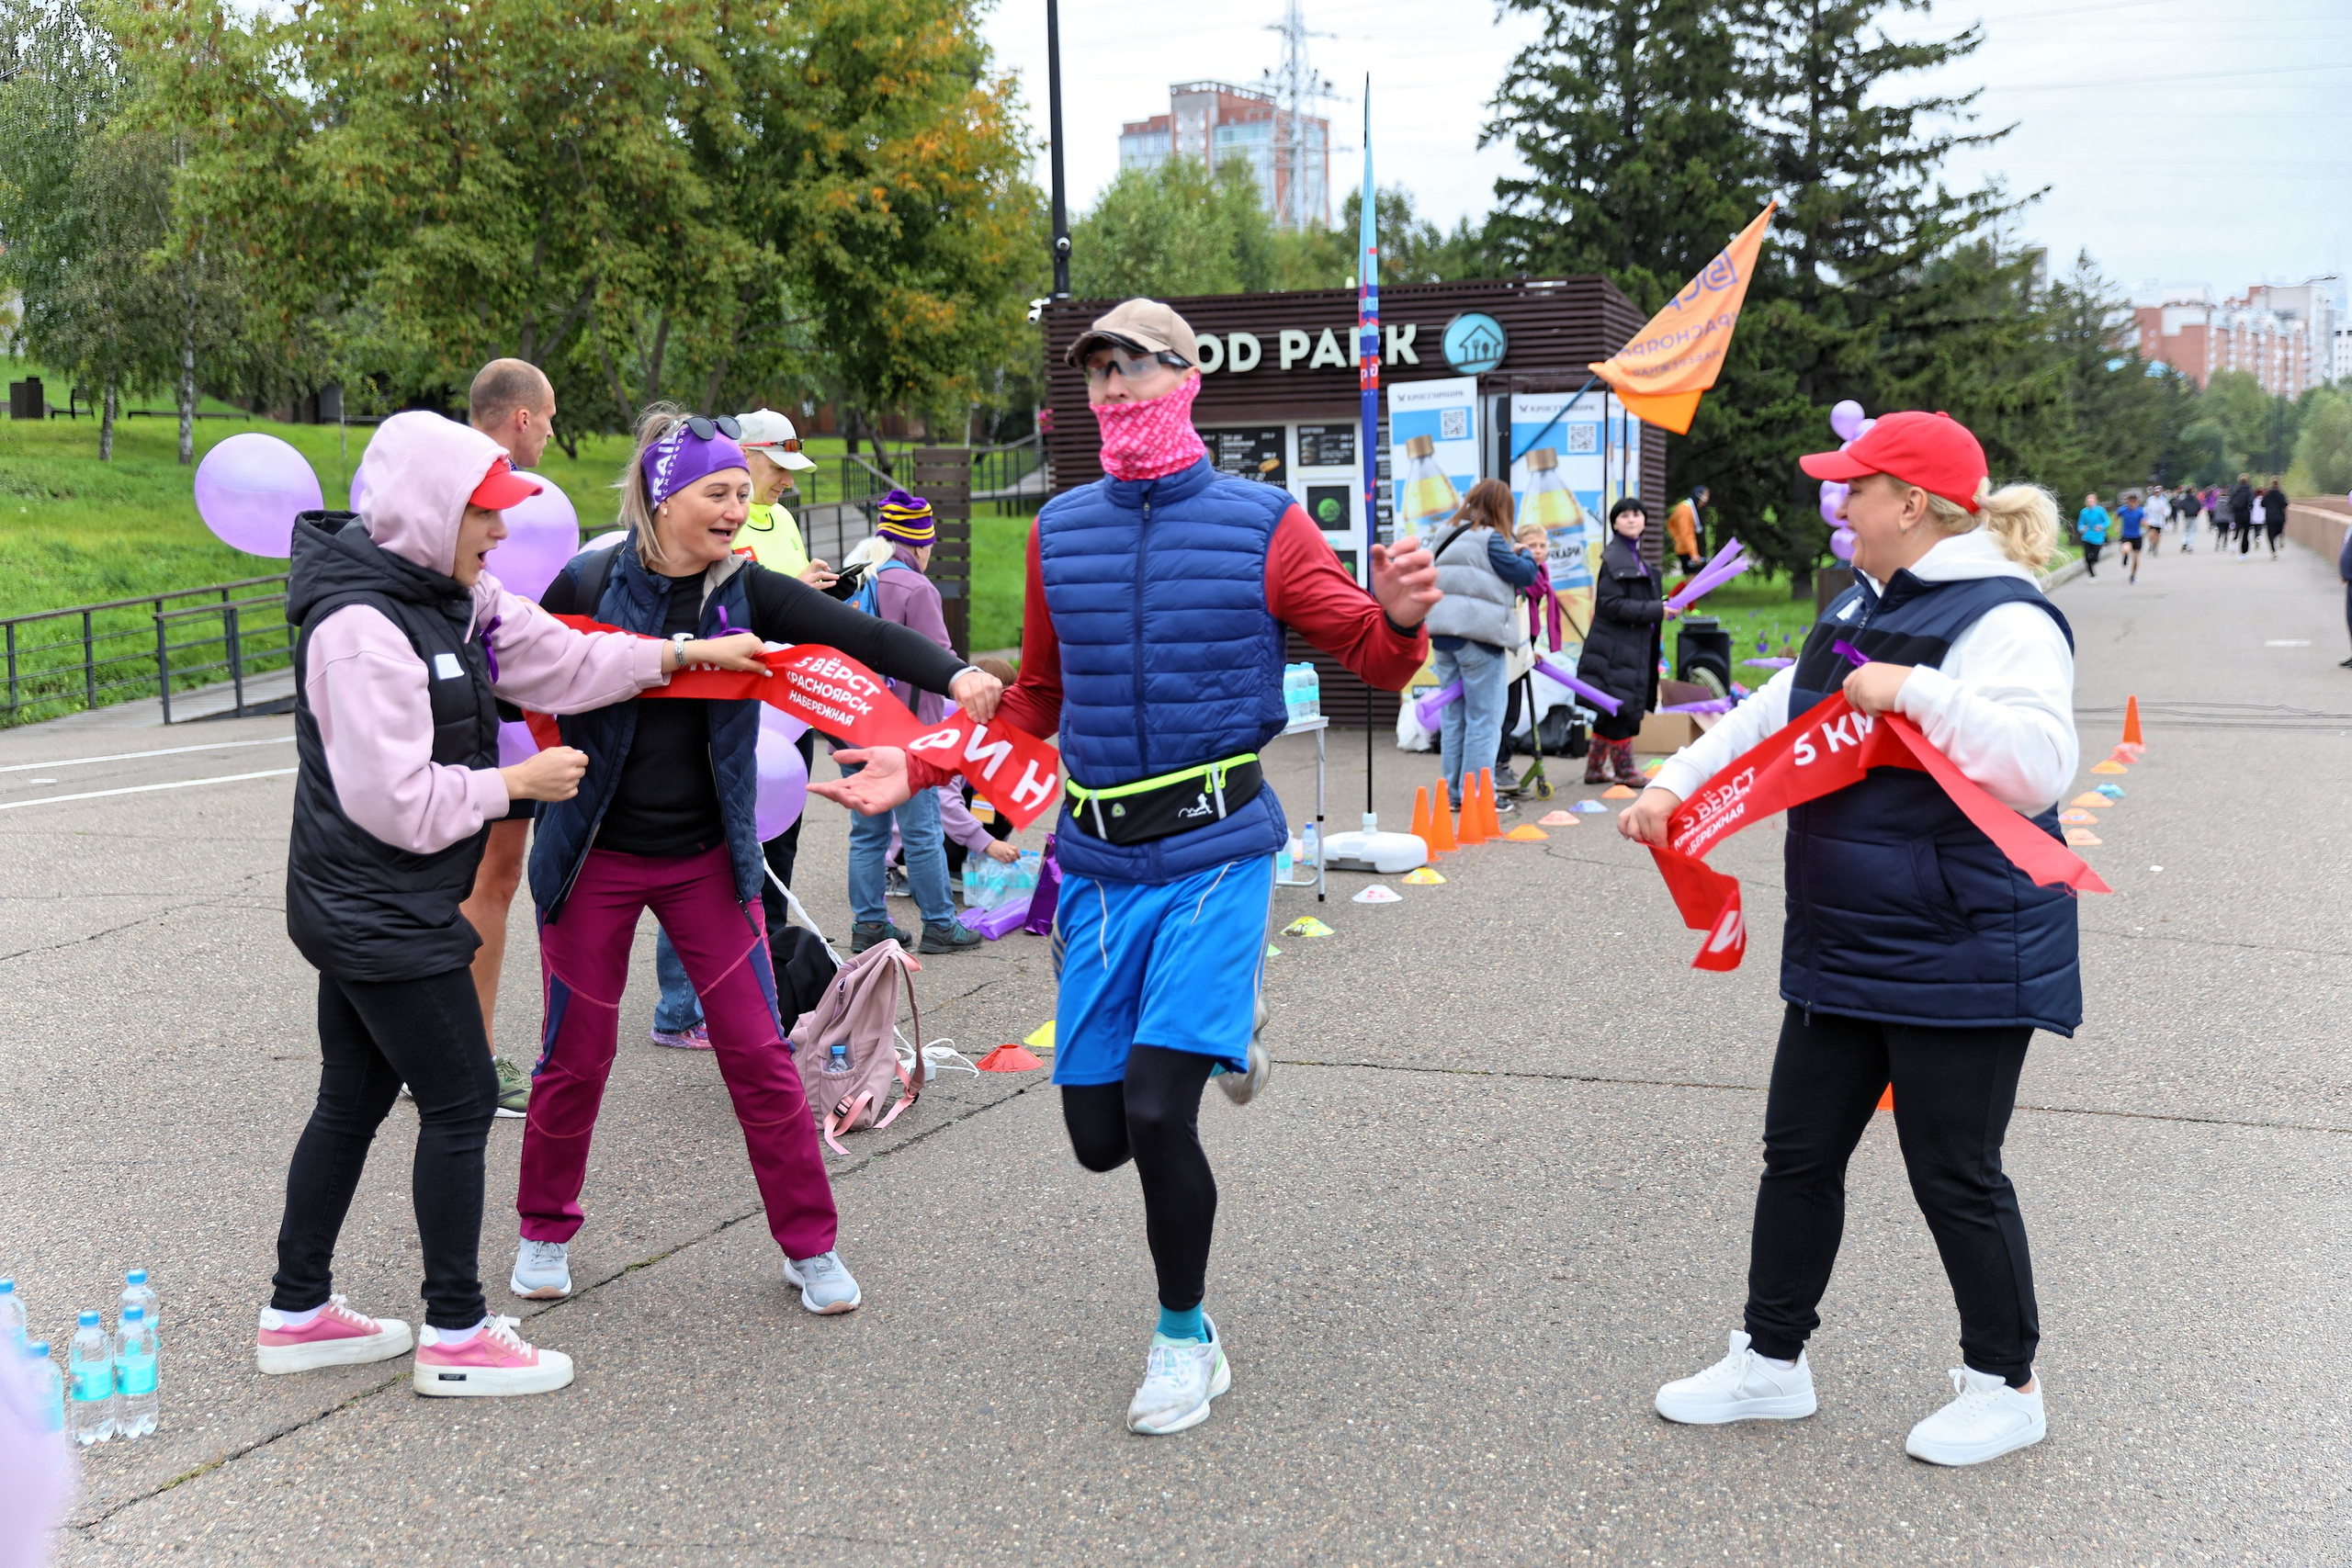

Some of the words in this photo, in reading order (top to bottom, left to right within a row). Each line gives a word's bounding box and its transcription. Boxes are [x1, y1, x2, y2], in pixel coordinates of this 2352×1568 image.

[794, 656, 814, 668] 5
[808, 657, 881, 697] ВЁРСТ
[788, 689, 855, 727] НАБЕРЕЖНАЯ
[1793, 731, 1816, 766] 5
[1692, 766, 1756, 821] ВЁРСТ
